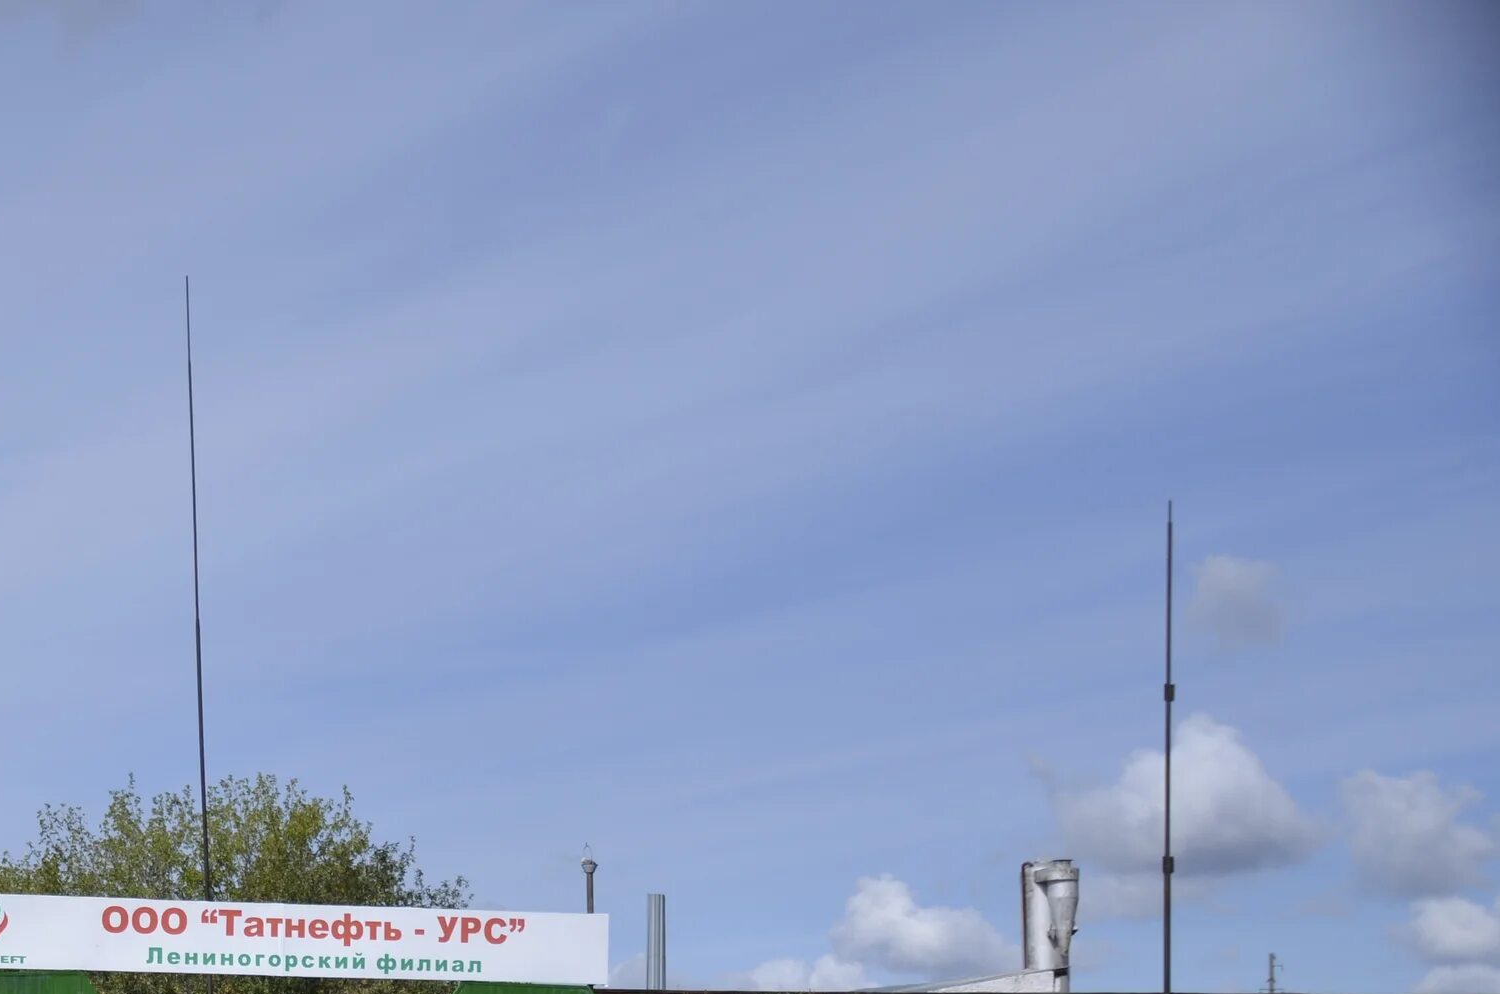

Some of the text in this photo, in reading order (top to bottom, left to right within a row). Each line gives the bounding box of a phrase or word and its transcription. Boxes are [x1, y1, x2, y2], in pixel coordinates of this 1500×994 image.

[101, 905, 188, 936] ООО
[146, 946, 482, 974] Лениногорский филиал
